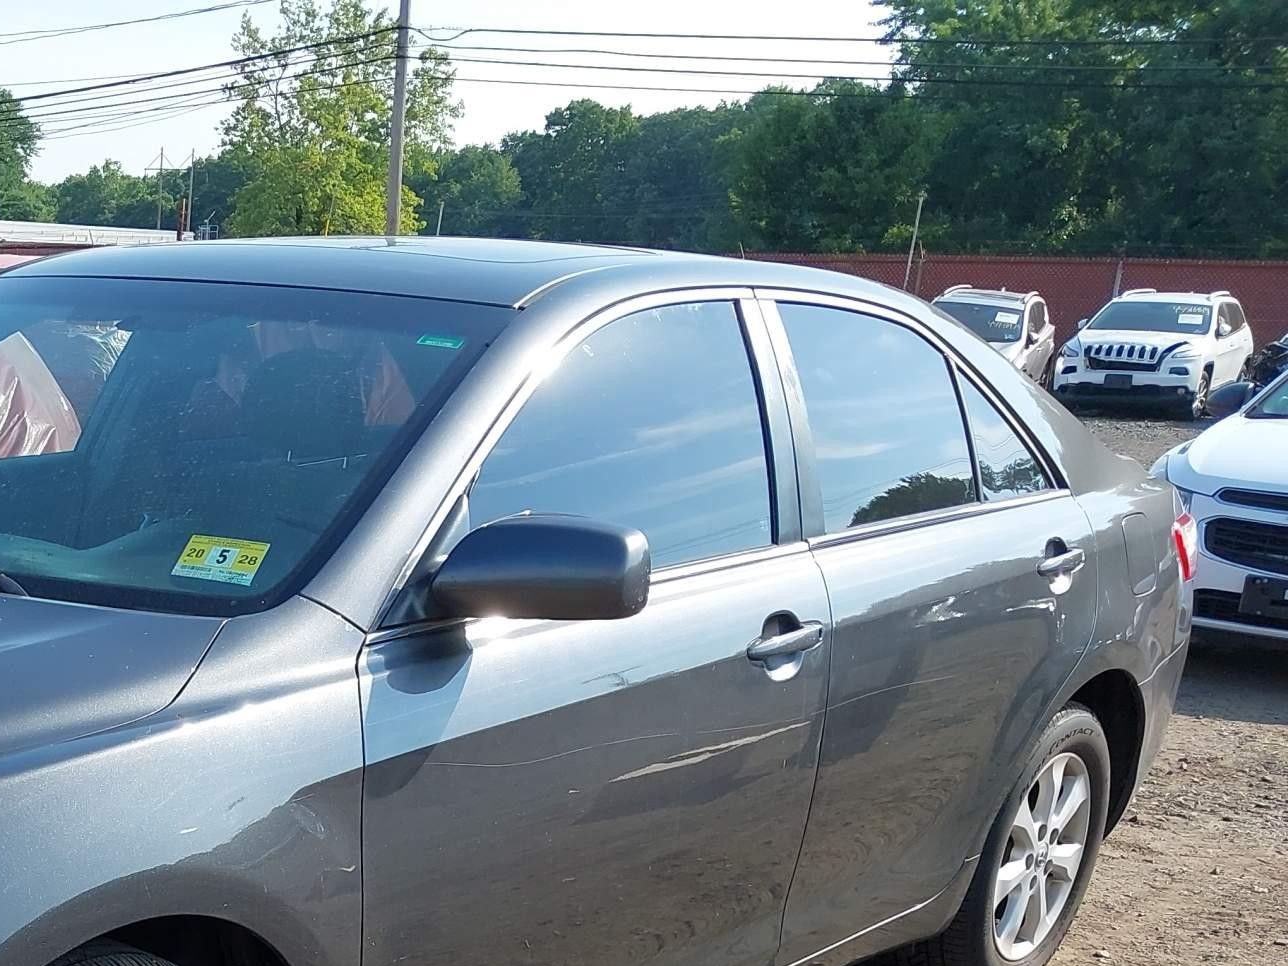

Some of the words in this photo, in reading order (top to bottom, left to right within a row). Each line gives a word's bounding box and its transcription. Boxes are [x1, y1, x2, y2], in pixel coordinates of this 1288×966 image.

[187, 547, 205, 558] 20
[216, 549, 230, 564] 5
[238, 554, 258, 565] 28
